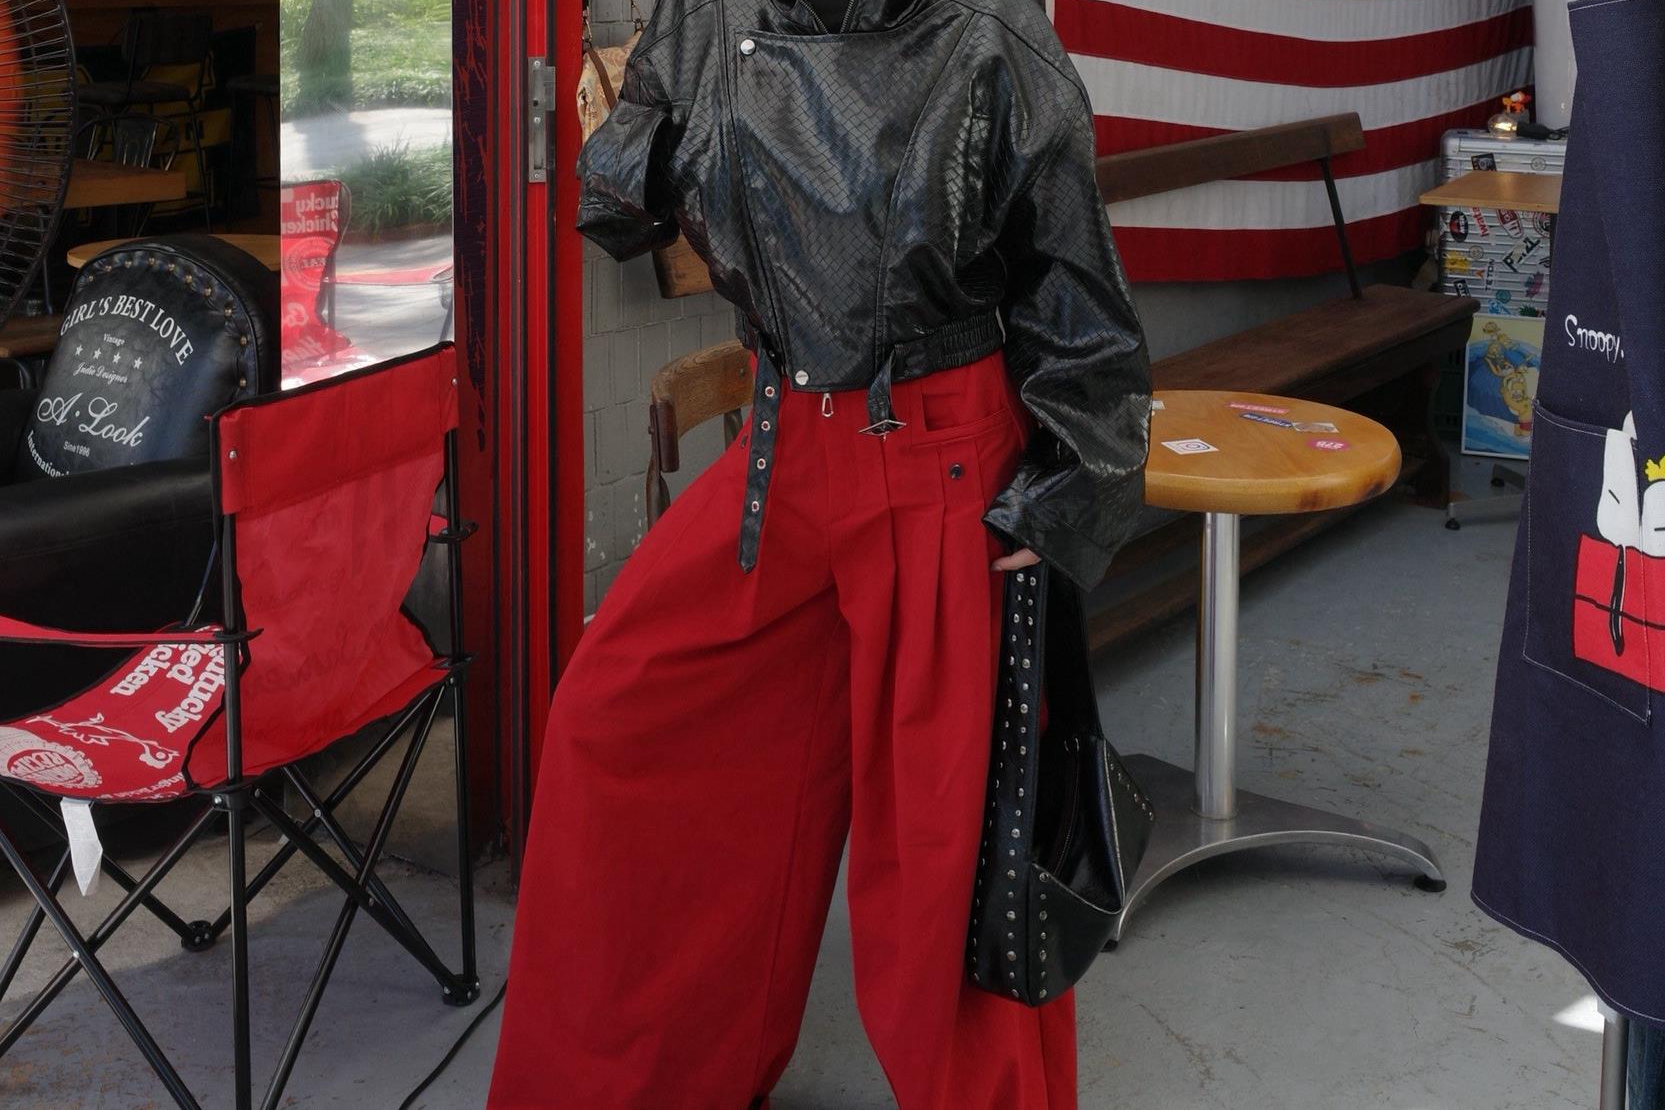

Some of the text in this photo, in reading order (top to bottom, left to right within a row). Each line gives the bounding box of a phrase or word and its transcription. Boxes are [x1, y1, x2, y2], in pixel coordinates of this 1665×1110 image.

[60, 295, 194, 366] GIRL'S BEST LOVE
[79, 397, 150, 447] Look
[28, 430, 69, 477] Internation
